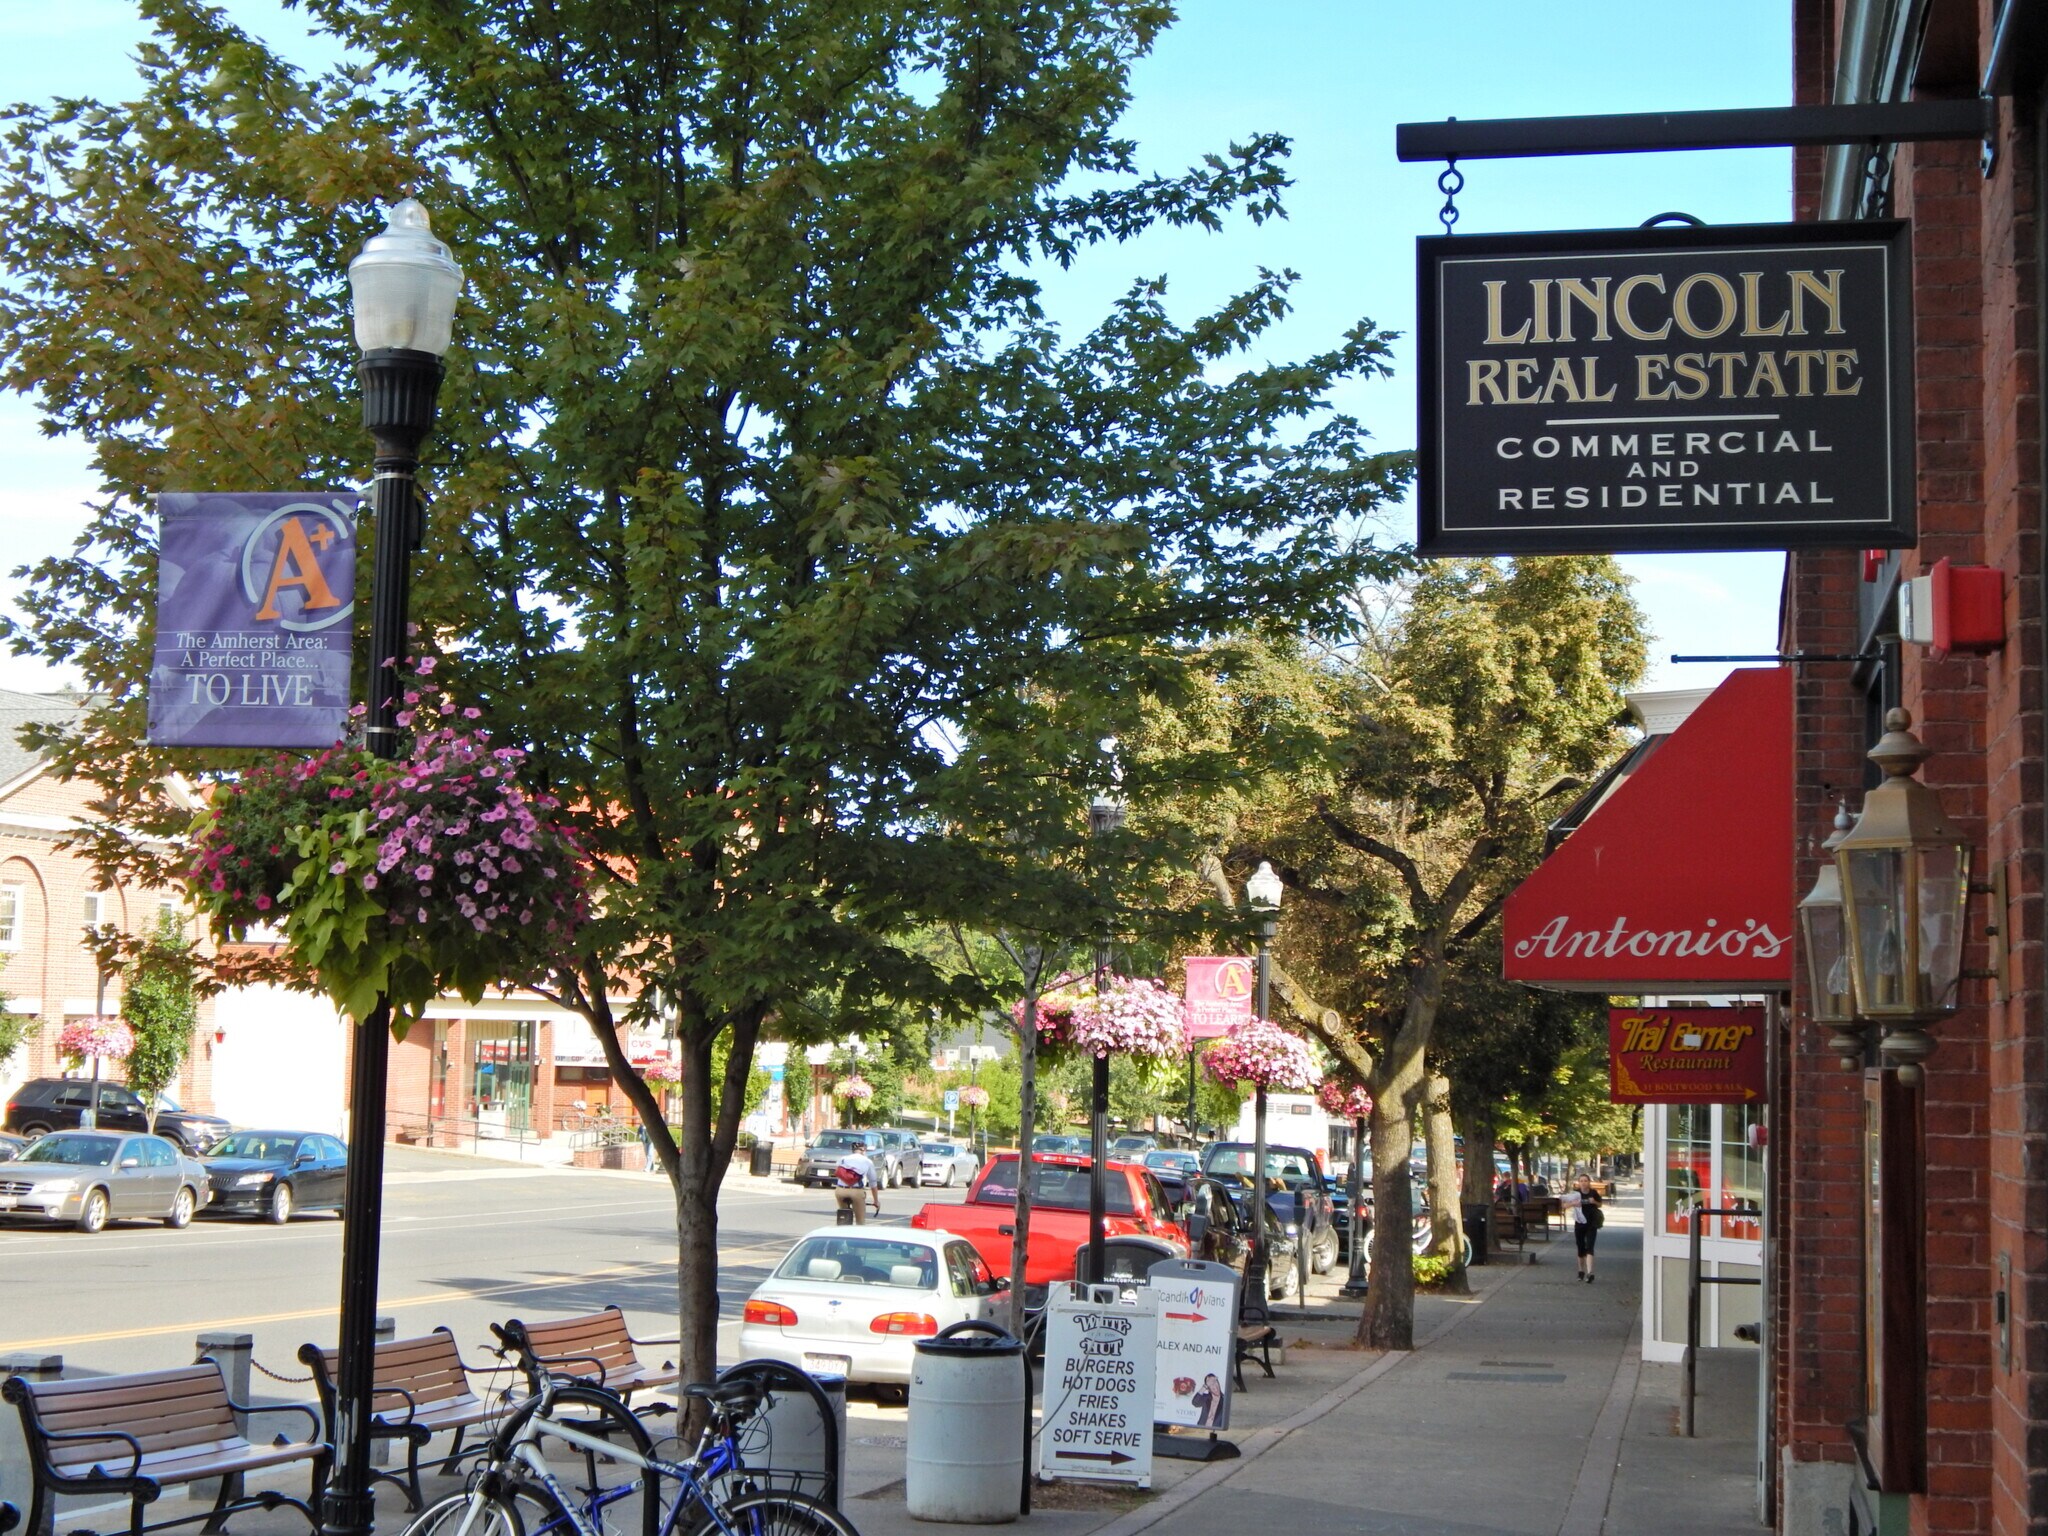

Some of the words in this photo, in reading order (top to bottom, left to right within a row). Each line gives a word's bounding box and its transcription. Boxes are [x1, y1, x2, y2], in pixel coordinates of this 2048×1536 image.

[1482, 269, 1846, 345] LINCOLN
[1466, 356, 1618, 406] REAL
[1634, 349, 1863, 401] ESTATE
[1496, 430, 1832, 459] COMMERCIAL
[1627, 461, 1699, 478] AND
[1498, 481, 1834, 510] RESIDENTIAL
[177, 633, 206, 648] The
[210, 633, 280, 649] Amherst
[285, 633, 328, 650] Area:
[181, 652, 194, 666] A
[199, 651, 255, 667] Perfect
[260, 652, 319, 668] Place...
[186, 673, 230, 705] TO
[240, 674, 313, 706] LIVE
[1514, 916, 1792, 958] Antonio's
[1191, 1013, 1207, 1025] TO
[1622, 1014, 1671, 1053] Thai
[631, 1040, 652, 1049] CVS
[1640, 1054, 1731, 1073] Restaurant
[1655, 1082, 1713, 1091] BOLTWOOD
[1073, 1314, 1132, 1336] WHITE
[1080, 1337, 1123, 1356] HUT
[1156, 1340, 1181, 1352] ALEX
[1182, 1343, 1203, 1353] AND
[1065, 1358, 1135, 1375] BURGERS
[1062, 1375, 1093, 1391] HOT
[1095, 1377, 1137, 1393] DOGS
[1078, 1394, 1119, 1409] FRIES
[1069, 1411, 1127, 1428] SHAKES
[1053, 1428, 1091, 1444] SOFT
[1094, 1431, 1142, 1447] SERVE
